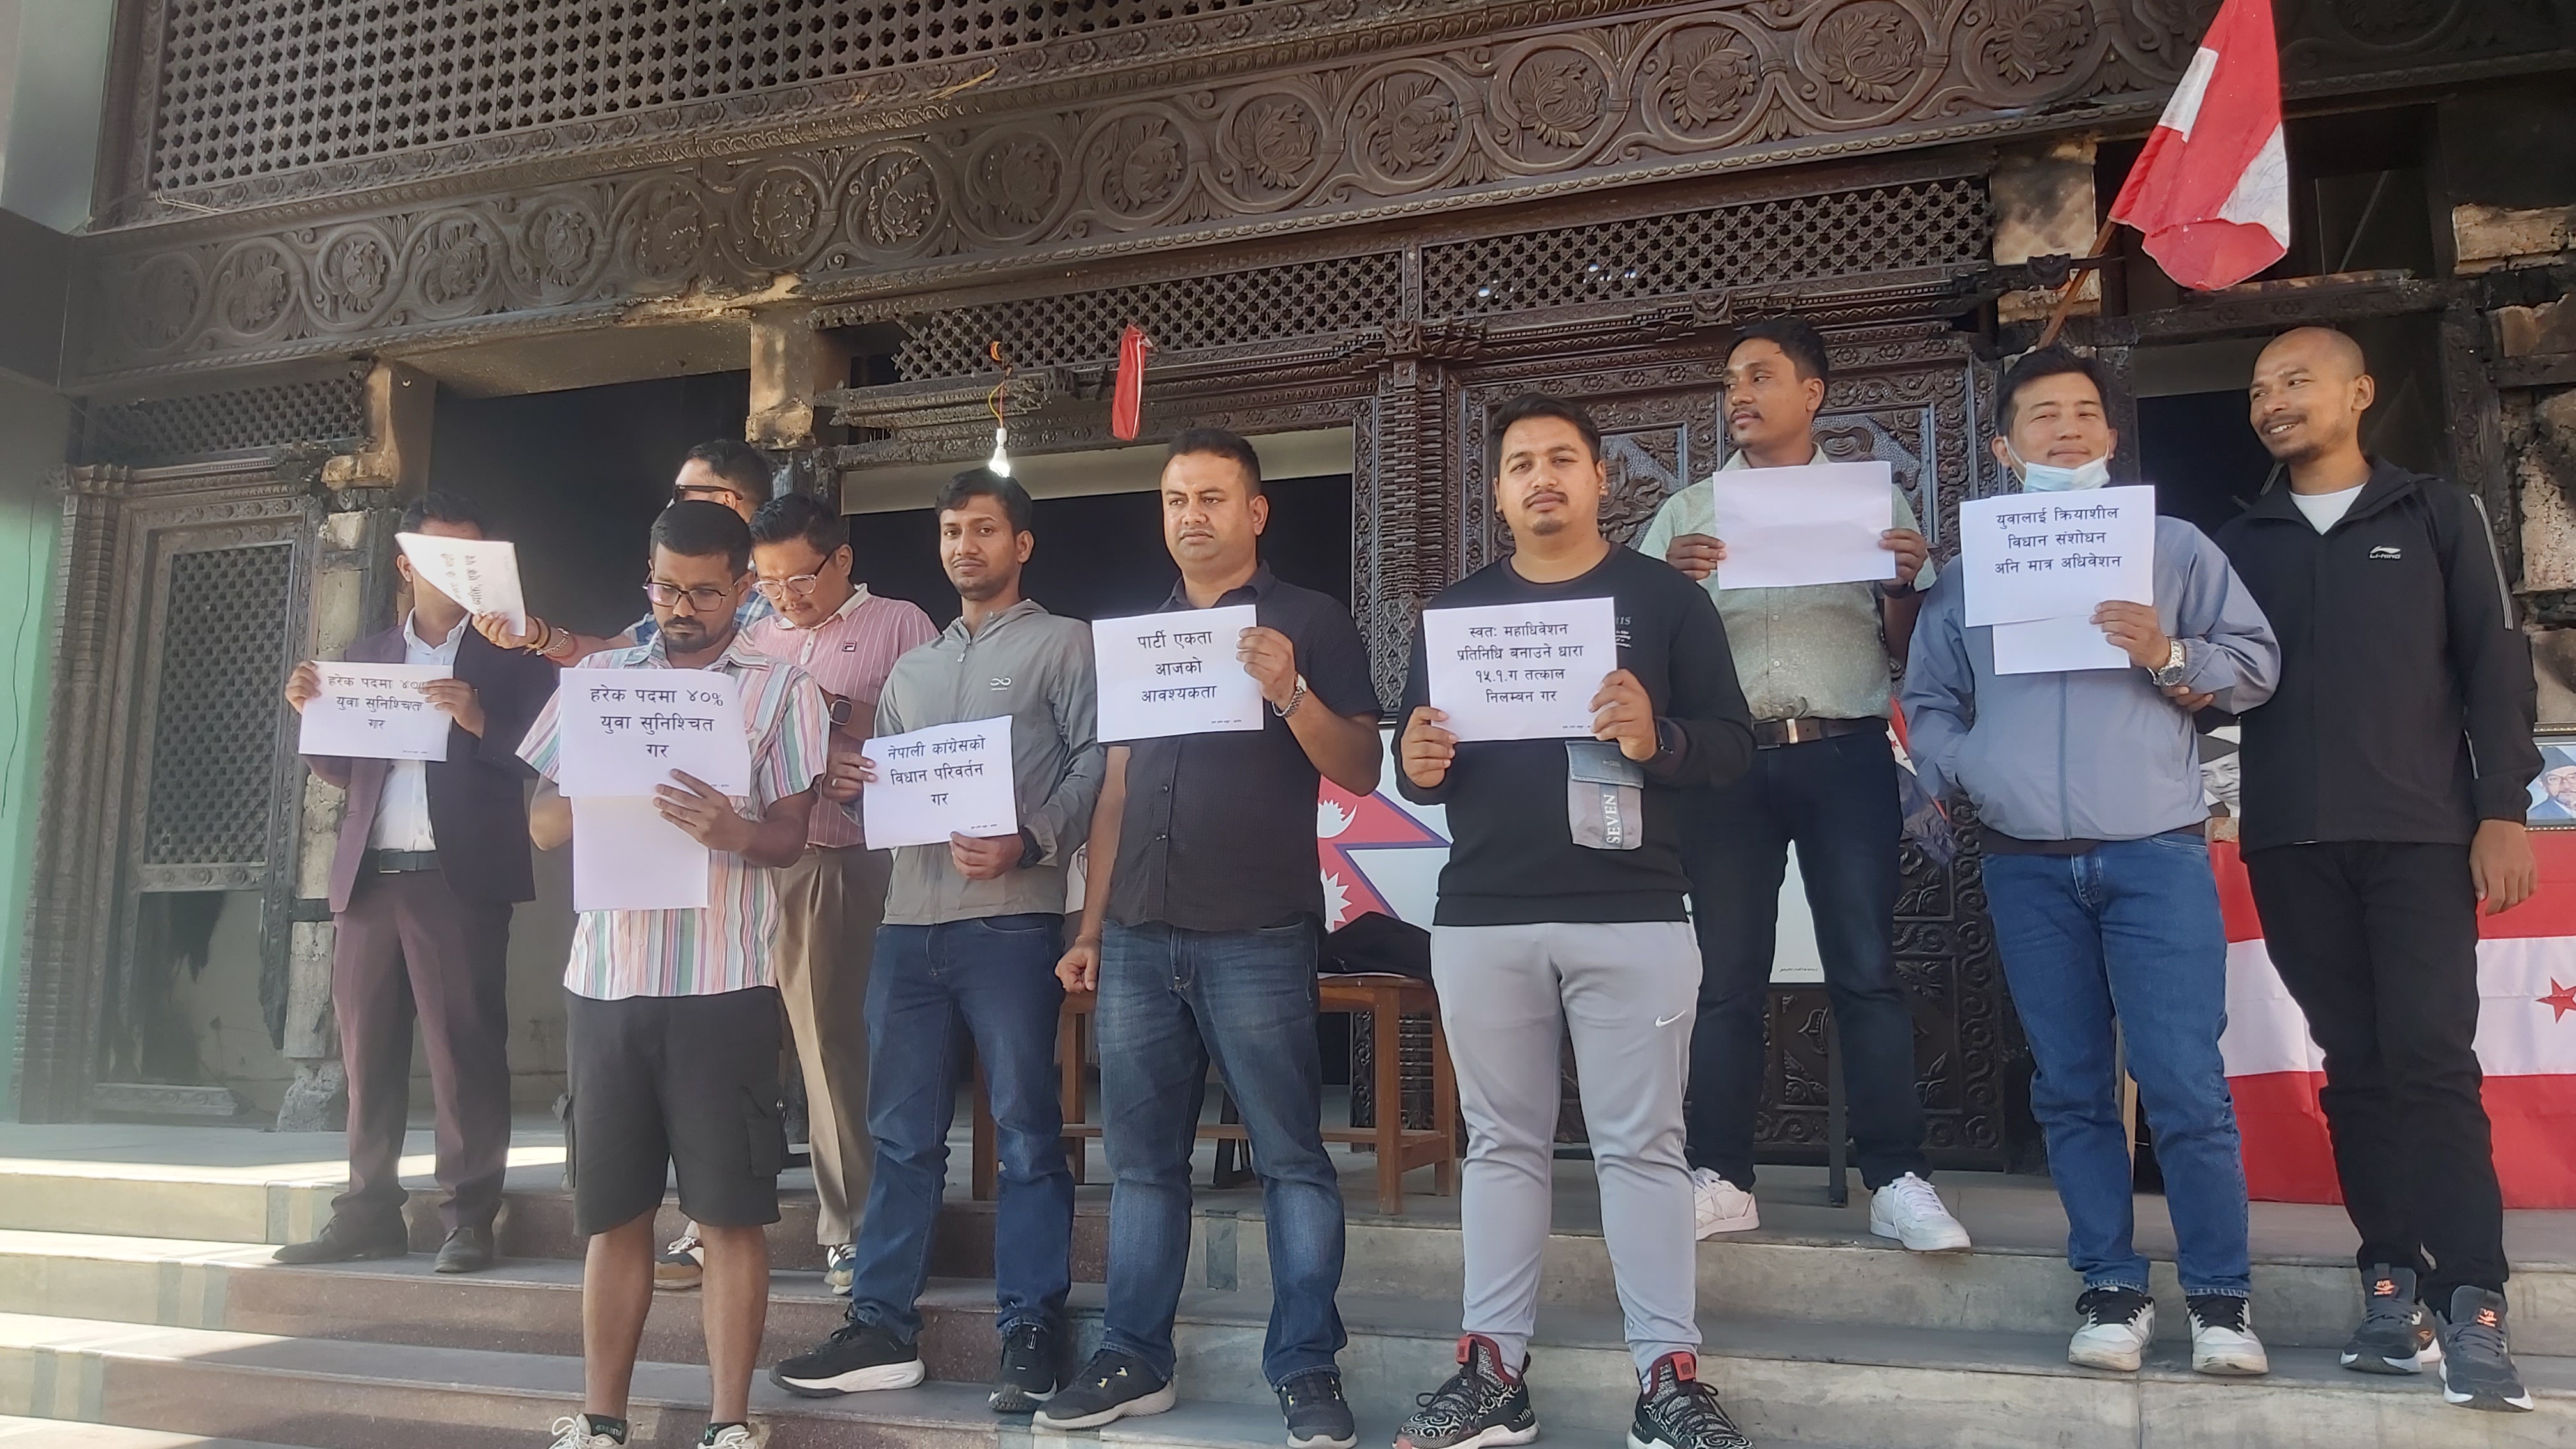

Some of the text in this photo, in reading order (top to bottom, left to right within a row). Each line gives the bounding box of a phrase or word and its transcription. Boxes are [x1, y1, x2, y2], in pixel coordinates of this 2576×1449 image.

[1995, 504, 2120, 530] युवालाई क्रियाशील
[2007, 529, 2107, 549] विधान संशोधन
[1995, 552, 2122, 574] अनि मात्र अधिवेशन
[1137, 629, 1213, 649] पार्टी एकता
[1468, 621, 1569, 638] स्वतः महाधिवेशन
[1457, 643, 1584, 661] प्रतिनिधि बनाउने धारा
[1155, 656, 1203, 676] आजको
[326, 673, 355, 687] हरेक
[360, 678, 394, 689] पदमा
[335, 694, 424, 713] युवा सुनिश्चित
[589, 684, 724, 707] हरेक पदमा ४०%
[1141, 686, 1218, 703] आवश्यकता
[1485, 688, 1558, 703] निलम्बन गर
[600, 712, 715, 735] युवा सुनिश्चित
[645, 744, 670, 758] गर
[887, 733, 986, 760] नेपाली कांग्रेसको
[890, 759, 984, 786] विधान परिवर्तन
[930, 792, 949, 806] गर
[1603, 794, 1620, 844] SEVEN
